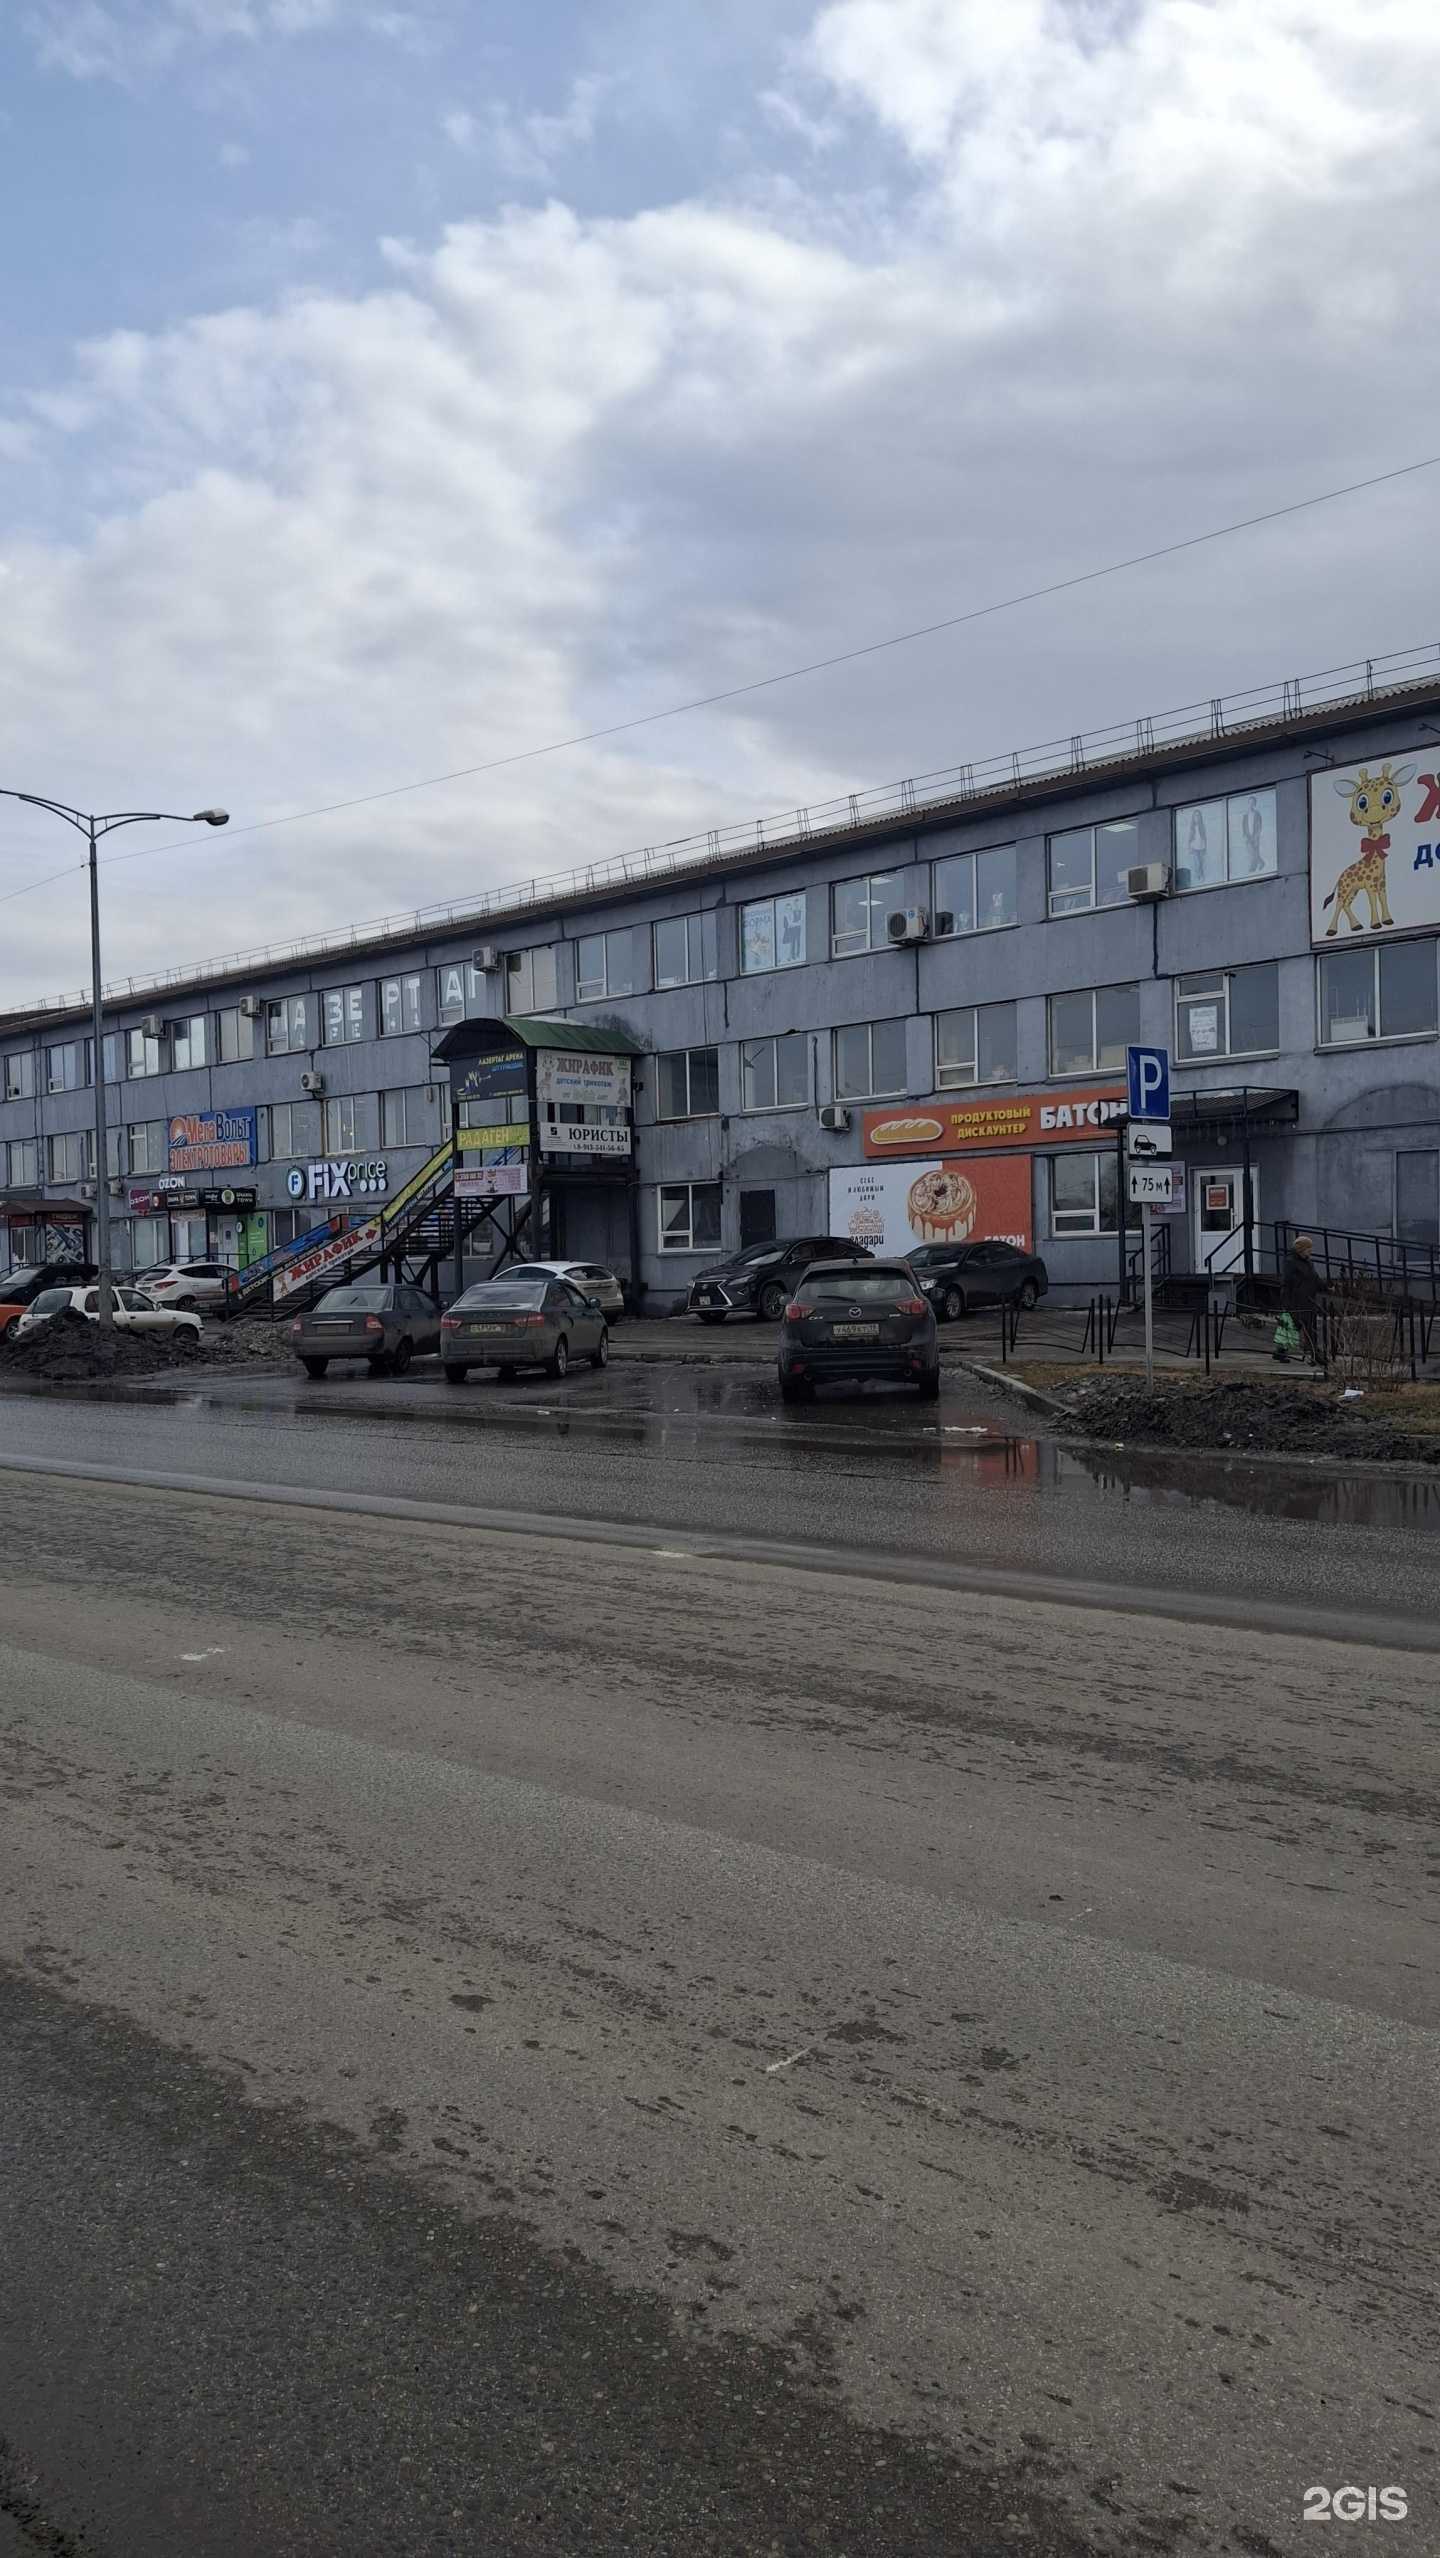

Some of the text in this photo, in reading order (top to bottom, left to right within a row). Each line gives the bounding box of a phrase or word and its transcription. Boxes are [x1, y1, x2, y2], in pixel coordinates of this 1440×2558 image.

[556, 1058, 614, 1076] ЖИРАФИК
[1139, 1055, 1162, 1110] P
[951, 1106, 1031, 1125] ПРОДУКТОВЫЙ
[569, 1128, 628, 1142] ЮРИСТЫ
[957, 1123, 1026, 1139] ДИСКАУНТЕР
[169, 1142, 249, 1171] ЭЛЕКТРОТОВАРЫ
[159, 1176, 185, 1189] OZON
[1142, 1178, 1154, 1195] 75
[288, 1231, 362, 1281] ЖИРАФИК
